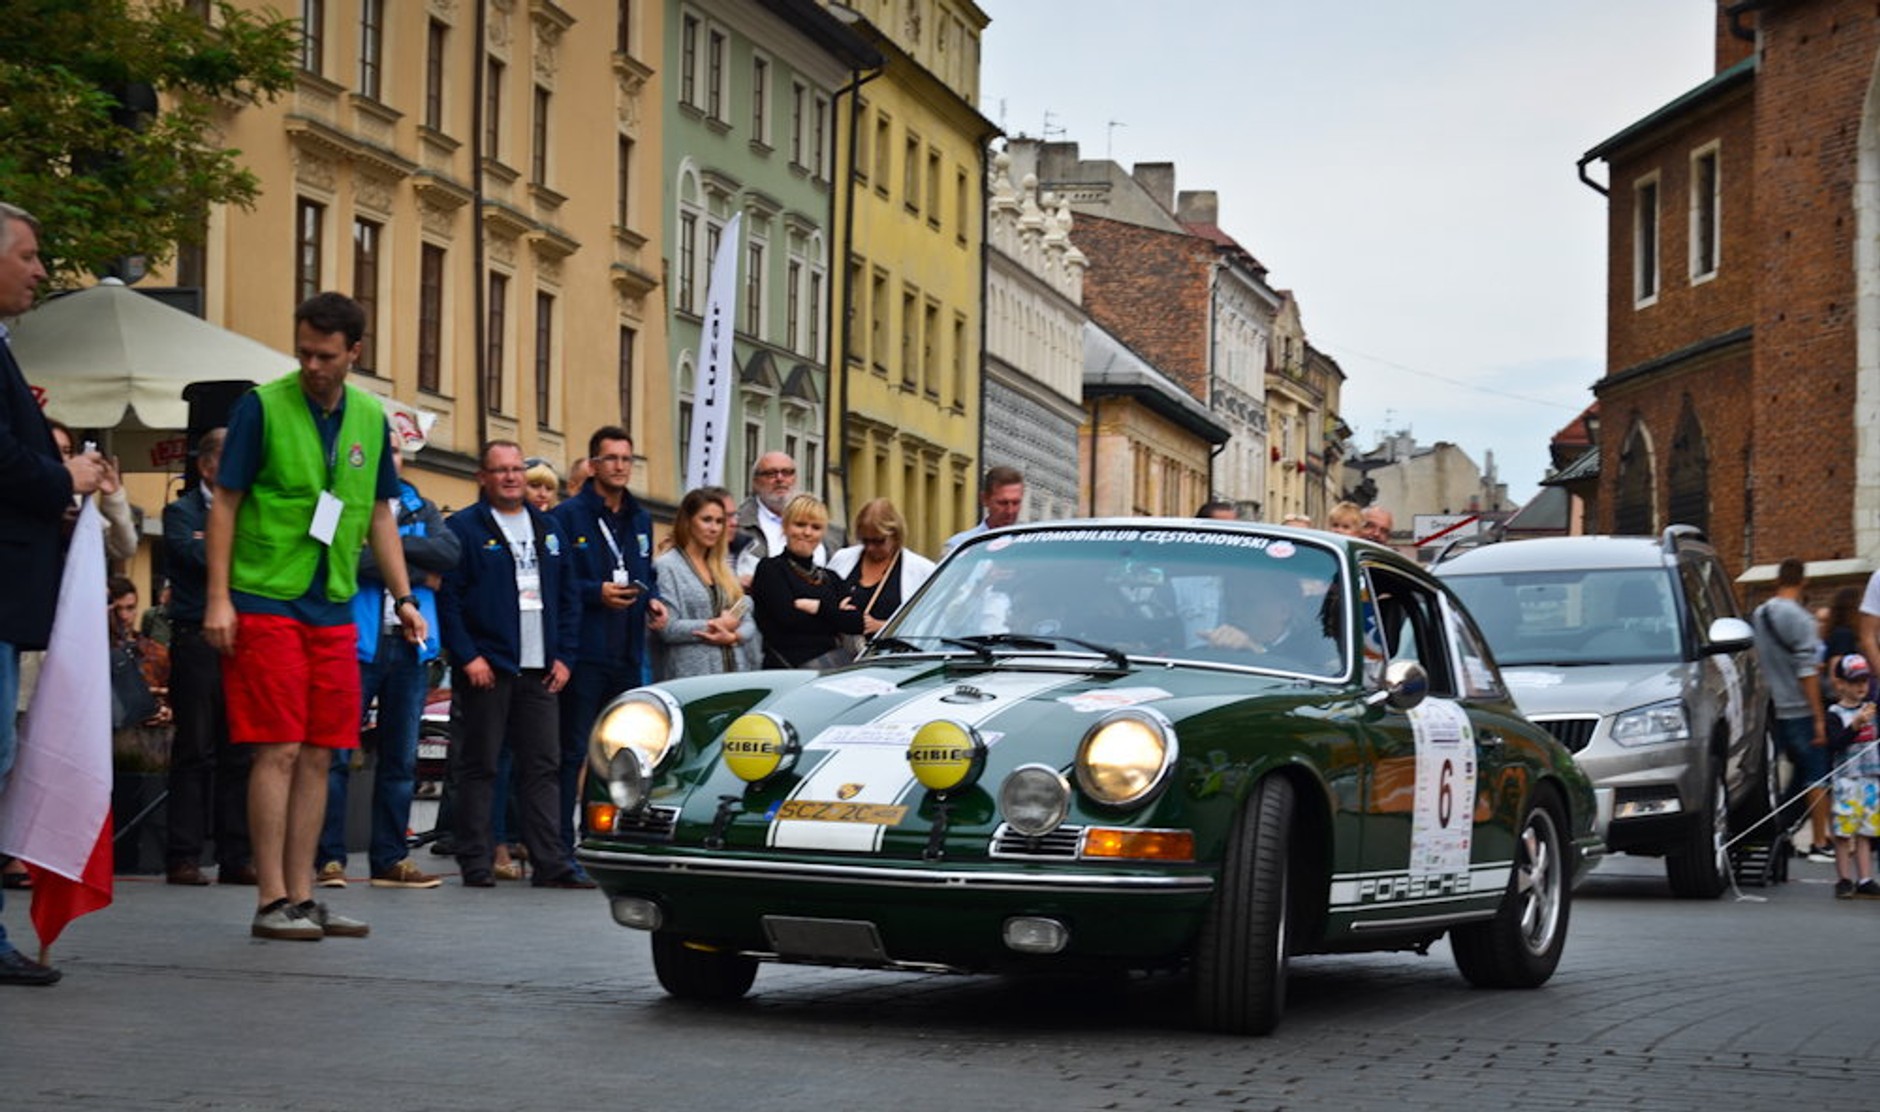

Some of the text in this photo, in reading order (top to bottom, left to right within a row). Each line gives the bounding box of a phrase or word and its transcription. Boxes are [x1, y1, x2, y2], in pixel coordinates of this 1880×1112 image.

[1013, 530, 1268, 549] AUTOMOBILKLUB CZĘSTOCHOWSKI
[725, 741, 772, 754] CIBIE
[912, 750, 962, 762] CIBIE
[1438, 758, 1453, 829] 6
[779, 802, 832, 820] SCZ
[1360, 873, 1470, 901] PORSCHE
